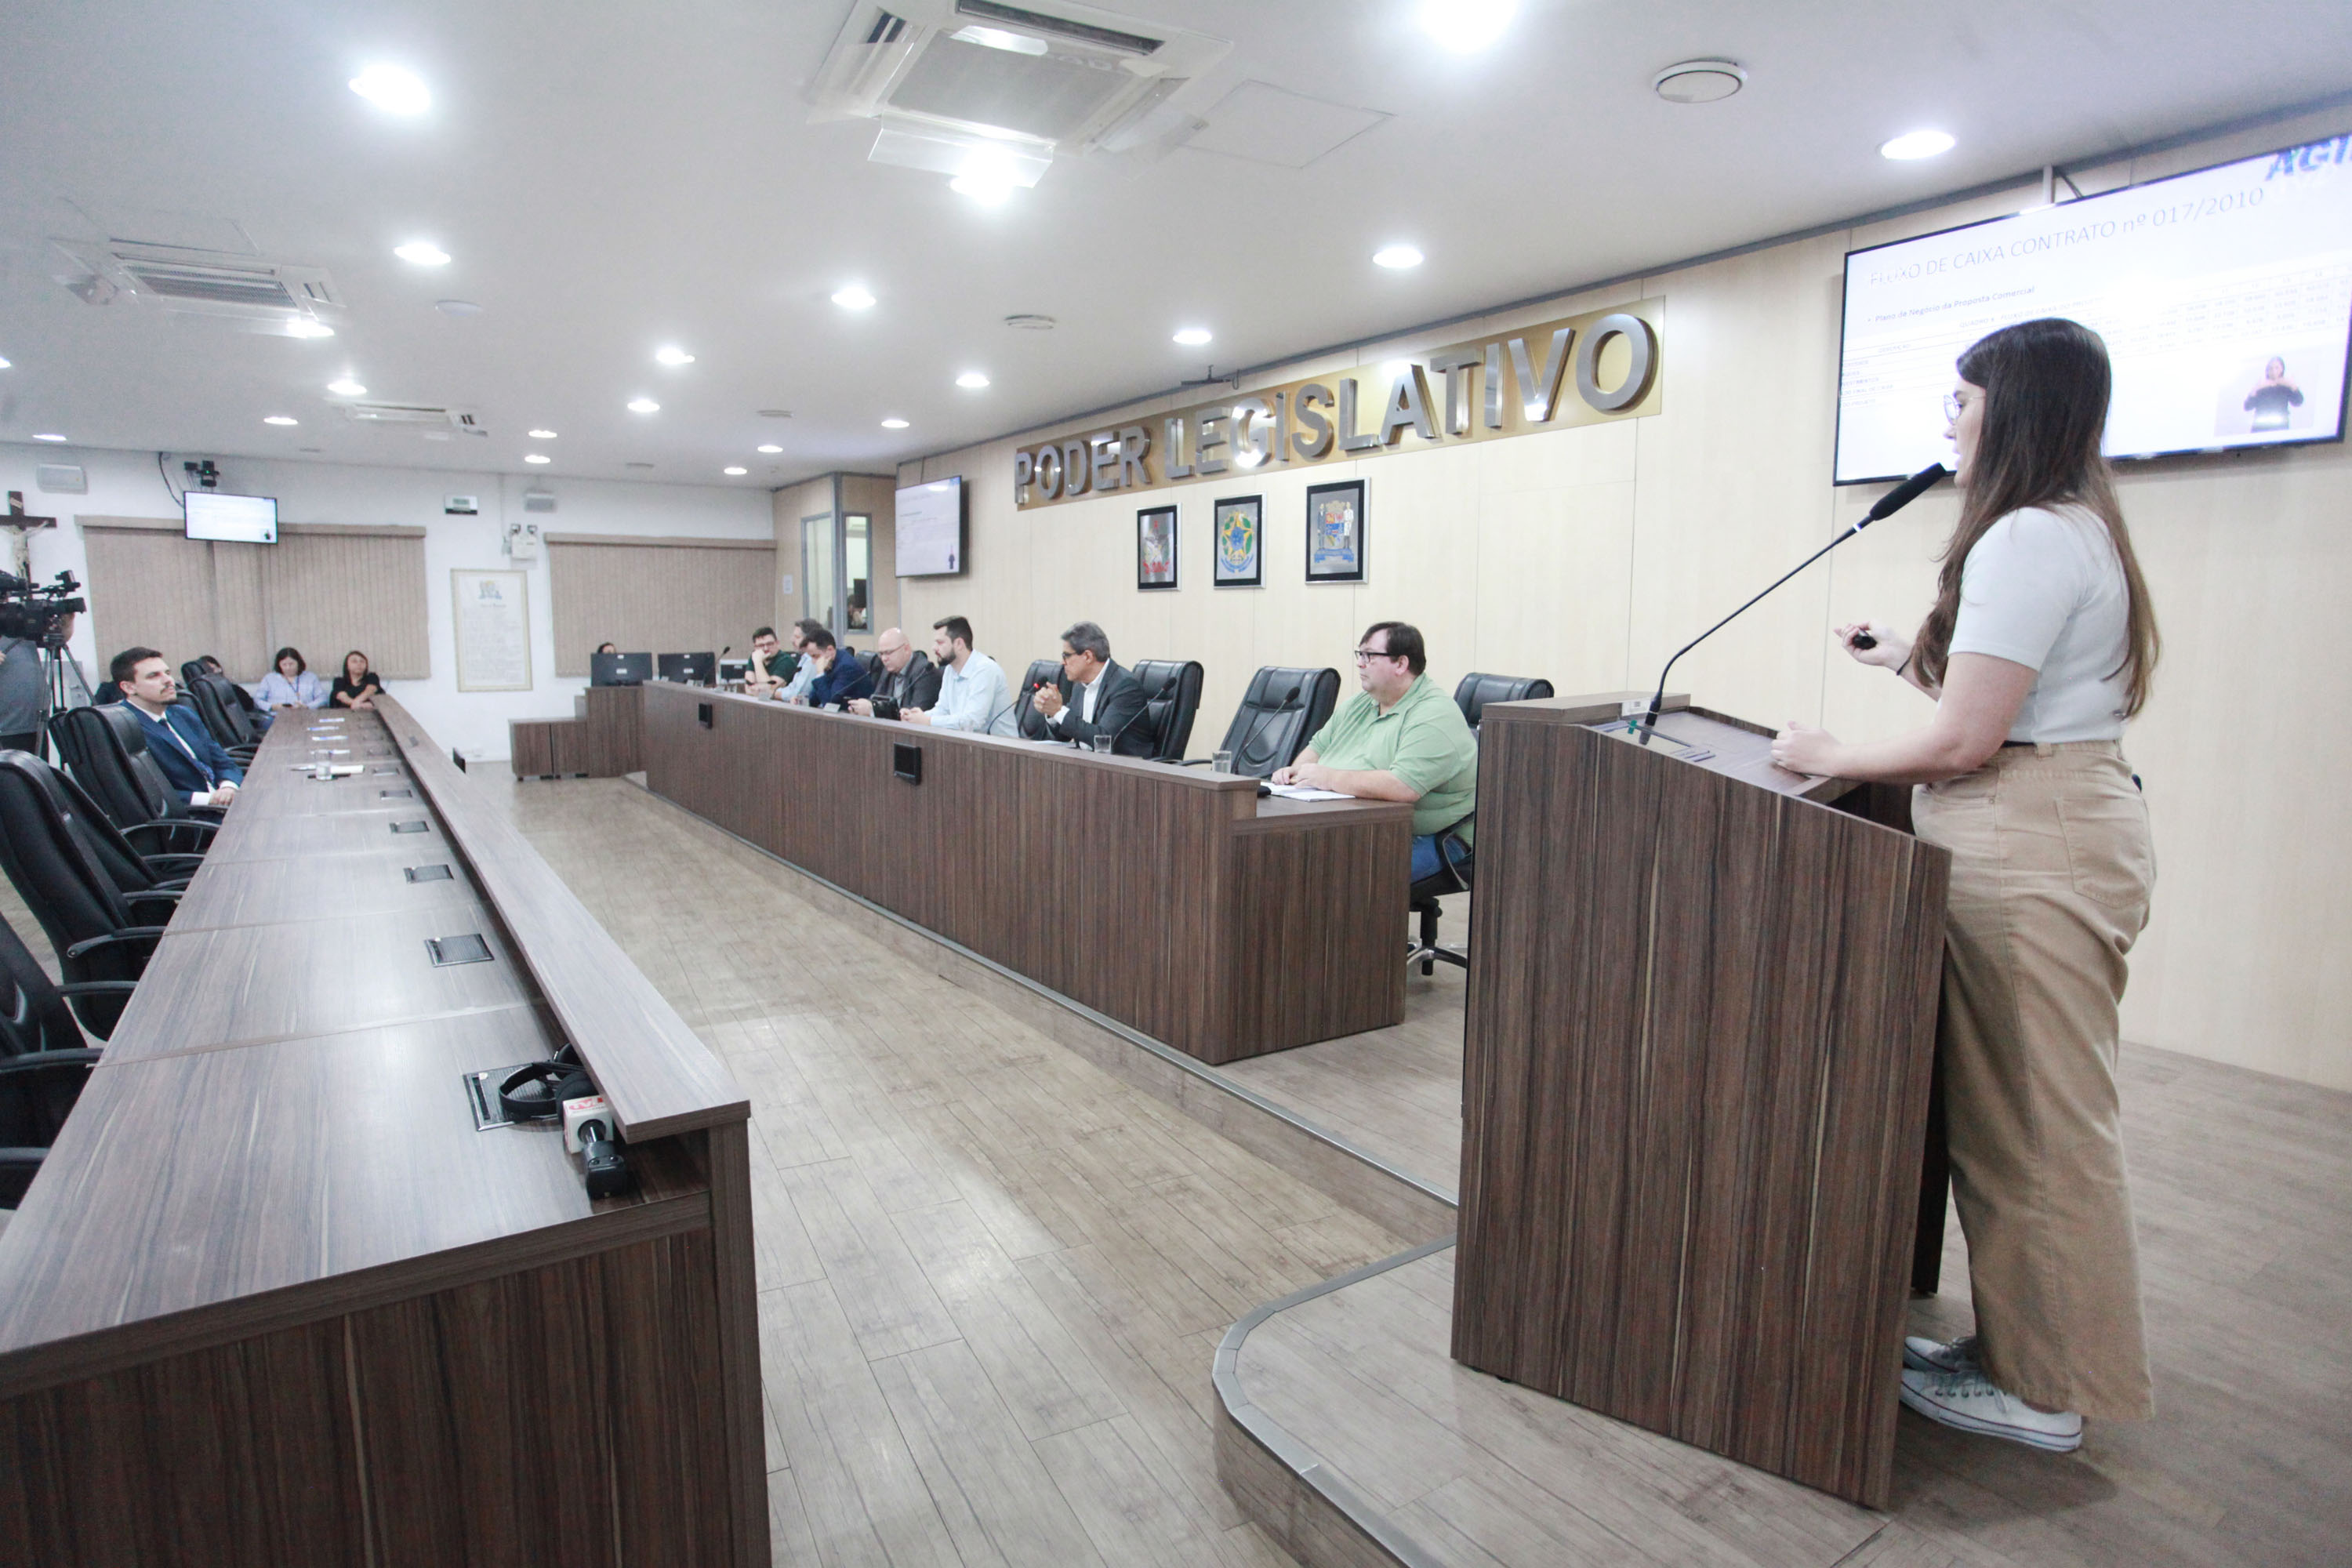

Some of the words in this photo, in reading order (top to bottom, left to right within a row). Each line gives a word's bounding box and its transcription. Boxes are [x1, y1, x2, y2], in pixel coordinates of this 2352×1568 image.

[2264, 136, 2352, 181] AGI
[1870, 263, 1921, 286] FLUXO
[1926, 256, 1948, 276] DE
[1953, 245, 2005, 270] CAIXA
[2010, 220, 2116, 257] CONTRATO
[2153, 187, 2264, 227] 017/2010
[1875, 314, 1896, 323] Plano
[1942, 301, 1952, 310] da
[1954, 296, 1990, 308] Proposta
[1992, 286, 2035, 299] Comercial
[1014, 426, 1152, 505] PODER
[1163, 314, 1659, 480] LEGISLATIVO
